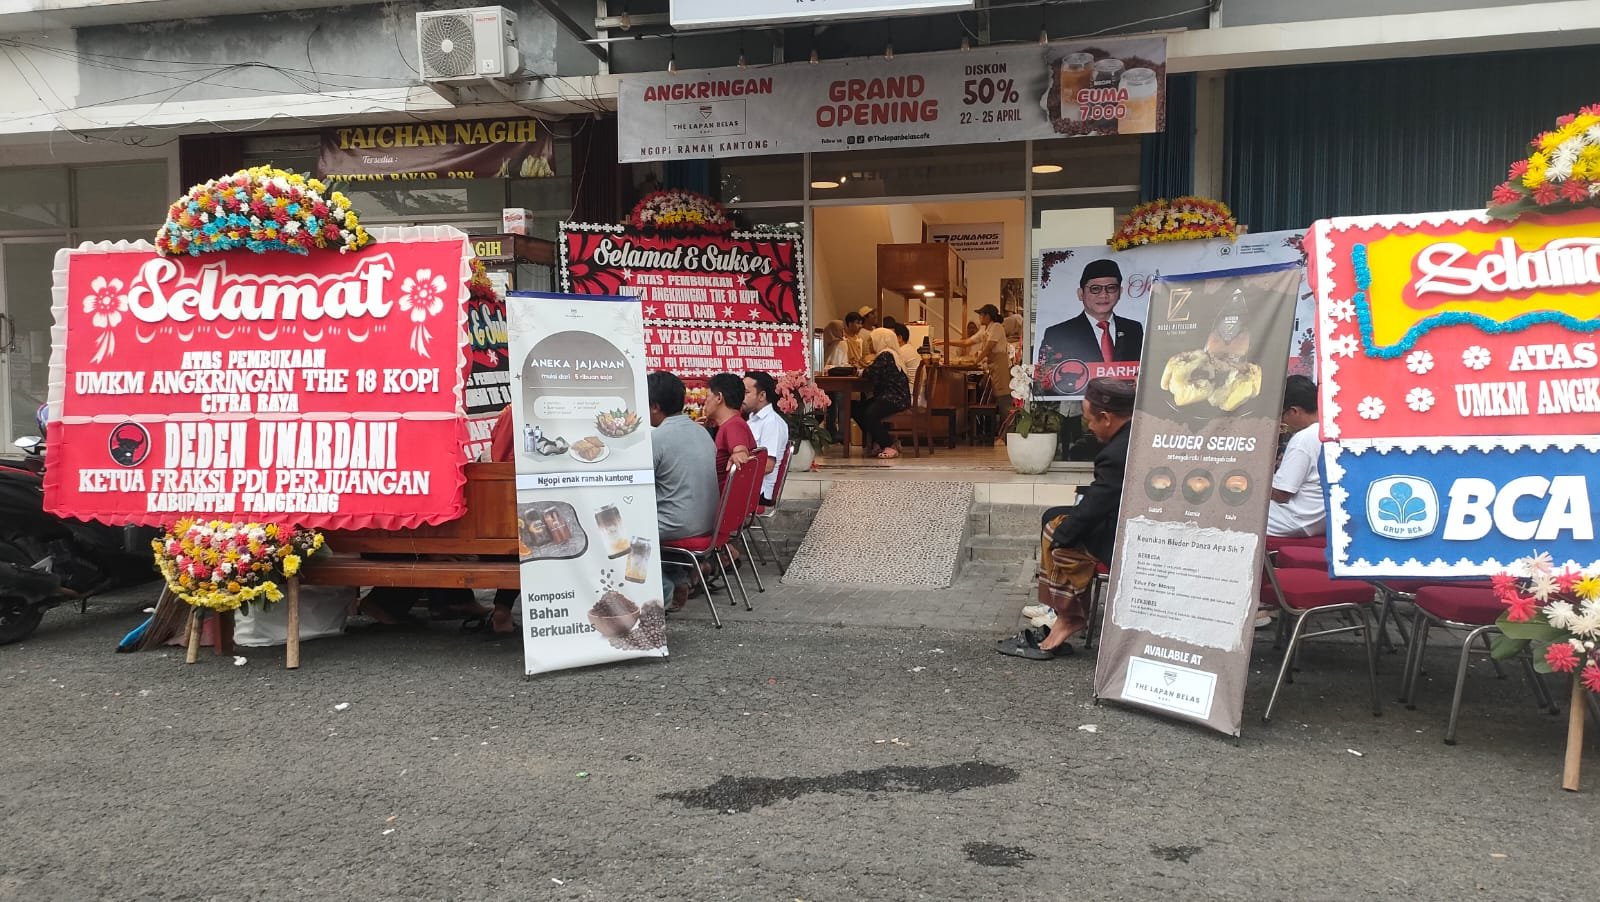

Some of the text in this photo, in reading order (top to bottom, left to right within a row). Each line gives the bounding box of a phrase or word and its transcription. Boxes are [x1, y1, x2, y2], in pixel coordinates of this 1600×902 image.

[965, 63, 1006, 76] DISKON
[644, 77, 773, 102] ANGKRINGAN
[829, 75, 925, 102] GRAND
[962, 78, 1019, 105] 50%
[1077, 87, 1129, 104] CUMA
[816, 100, 938, 127] OPENING
[960, 112, 972, 124] 22
[982, 111, 994, 123] 25
[996, 109, 1022, 122] APRIL
[1080, 104, 1127, 121] 7.000
[689, 121, 714, 130] LAPAN
[716, 120, 739, 129] BELAS
[337, 119, 536, 151] TAICHAN NAGIH
[640, 145, 671, 157] NGOPI
[677, 143, 713, 155] RAMAH
[720, 140, 769, 151] KANTONG
[362, 155, 393, 165] Tersedia
[950, 233, 1000, 241] DUNAMOS
[593, 238, 773, 274] Selamat & Sukses
[637, 274, 733, 287] ATAS PEMBUKAAN
[128, 257, 394, 323] Selamat
[652, 287, 707, 302] ANGKRINGAN
[710, 289, 726, 303] THE
[728, 290, 738, 303] 18
[739, 290, 760, 304] KOPI
[664, 303, 716, 319] CITRA RAYA
[182, 349, 325, 370] ATAS PEMBUKAAN
[651, 344, 664, 355] PDI
[668, 344, 712, 356] PERJUANGAN
[716, 345, 734, 357] KOTA
[737, 345, 775, 358] TANGERANG
[1508, 342, 1598, 371] ATAS
[531, 359, 625, 371] ANEKA JAJANAN
[664, 357, 677, 368] PDI
[679, 357, 723, 369] PERJUANGAN
[726, 358, 743, 370] KOTA
[746, 358, 782, 370] TANGERANG
[75, 371, 145, 395] UMKM
[150, 369, 294, 393] ANGKRINGAN
[303, 369, 348, 393] THE
[356, 369, 376, 393] 18
[383, 368, 440, 393] KOPI
[201, 393, 299, 413] CITRA RAYA
[1454, 381, 1530, 417] UMKM
[165, 421, 397, 471] DEDEN UMARDANI
[1152, 434, 1257, 452] BLUDER SERIES
[79, 469, 430, 495] KETUA FRAKSI PDI PERJUANGAN
[537, 474, 634, 486] Ngopi enak ramah kantong
[147, 492, 339, 513] KABUPATEN TANGERANG
[1442, 475, 1594, 541] BCA
[1383, 525, 1423, 535] GRUP BCA
[1137, 534, 1166, 545] Keunikan
[1167, 538, 1189, 548] Bluder
[1212, 544, 1226, 553] Apa
[1227, 545, 1238, 553] Sih
[528, 590, 575, 603] Komposisi
[529, 607, 569, 620] Bahan
[530, 622, 596, 638] Berkualitas
[1144, 644, 1203, 665] AVAILABLE AT
[1135, 682, 1201, 704] THE LAPAN BELAS
